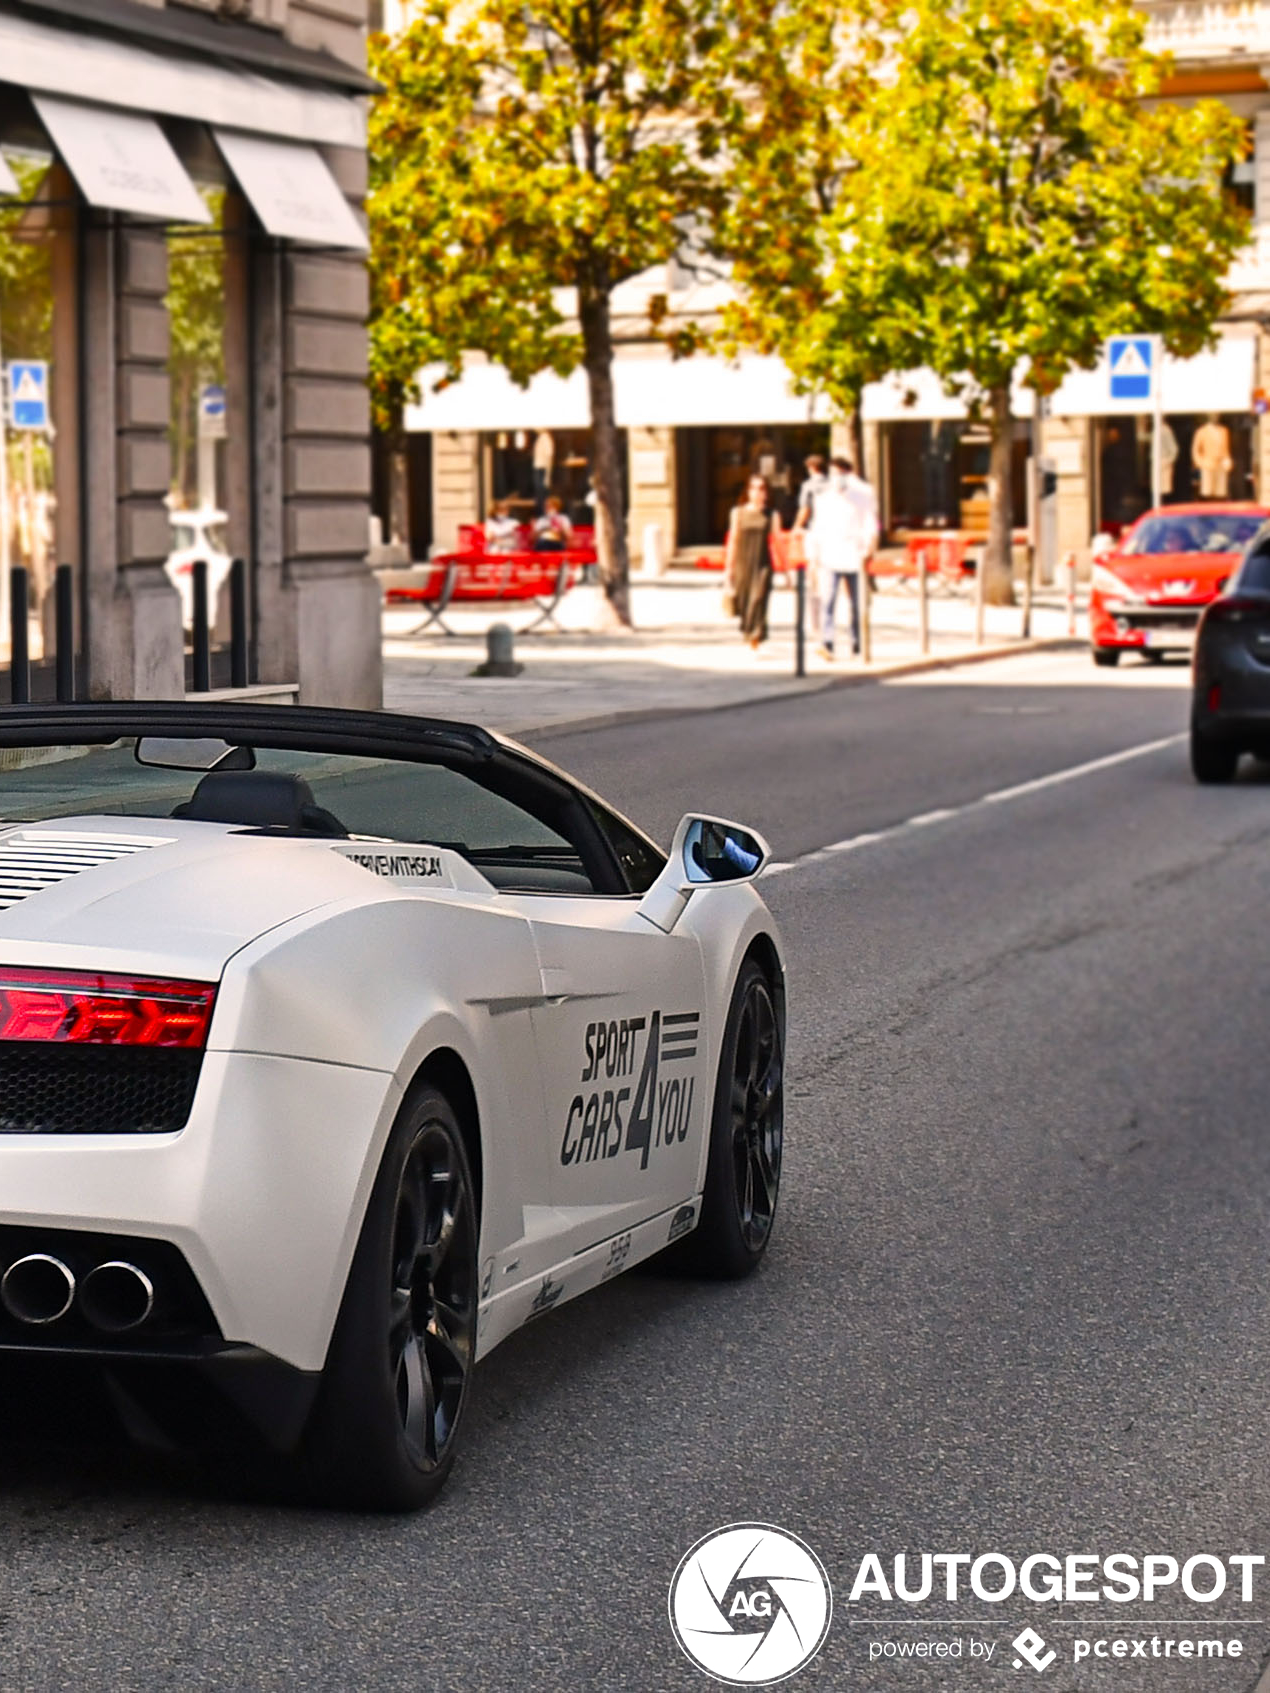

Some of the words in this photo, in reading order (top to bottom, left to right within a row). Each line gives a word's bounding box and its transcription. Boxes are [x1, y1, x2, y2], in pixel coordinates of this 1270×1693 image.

[560, 1087, 631, 1167] CARS
[625, 1010, 660, 1171] 4
[655, 1076, 695, 1148] YOU
[582, 1017, 646, 1082] SPORT
